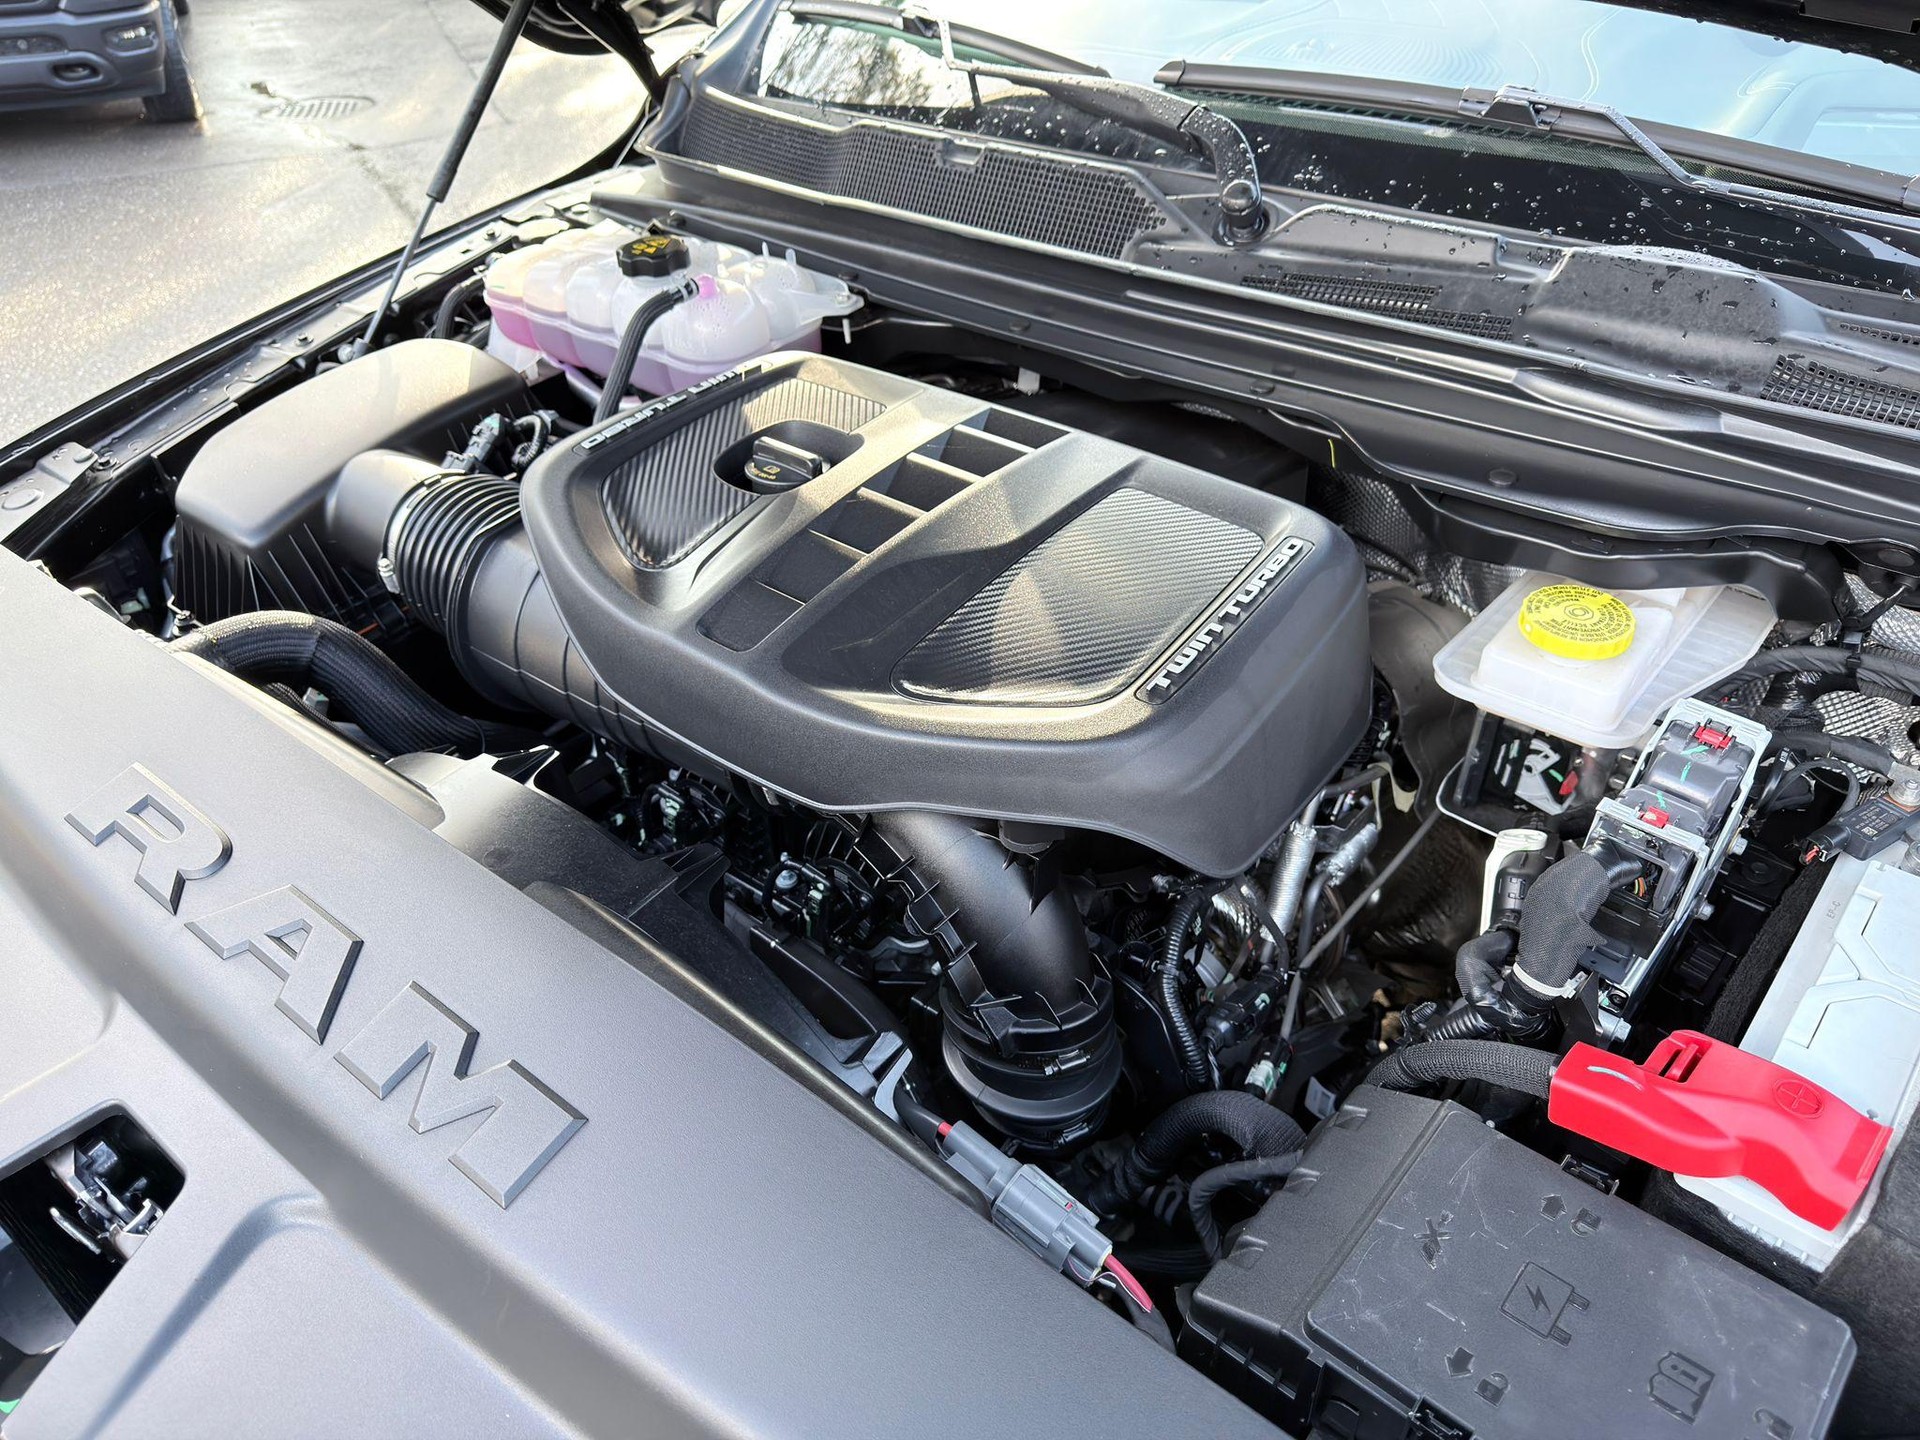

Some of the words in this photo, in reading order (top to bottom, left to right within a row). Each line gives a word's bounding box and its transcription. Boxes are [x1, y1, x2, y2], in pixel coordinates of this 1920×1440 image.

[581, 394, 687, 449] TURBO
[1146, 622, 1224, 691] TWIN
[1217, 538, 1304, 621] TURBO
[63, 761, 589, 1209] RAM
